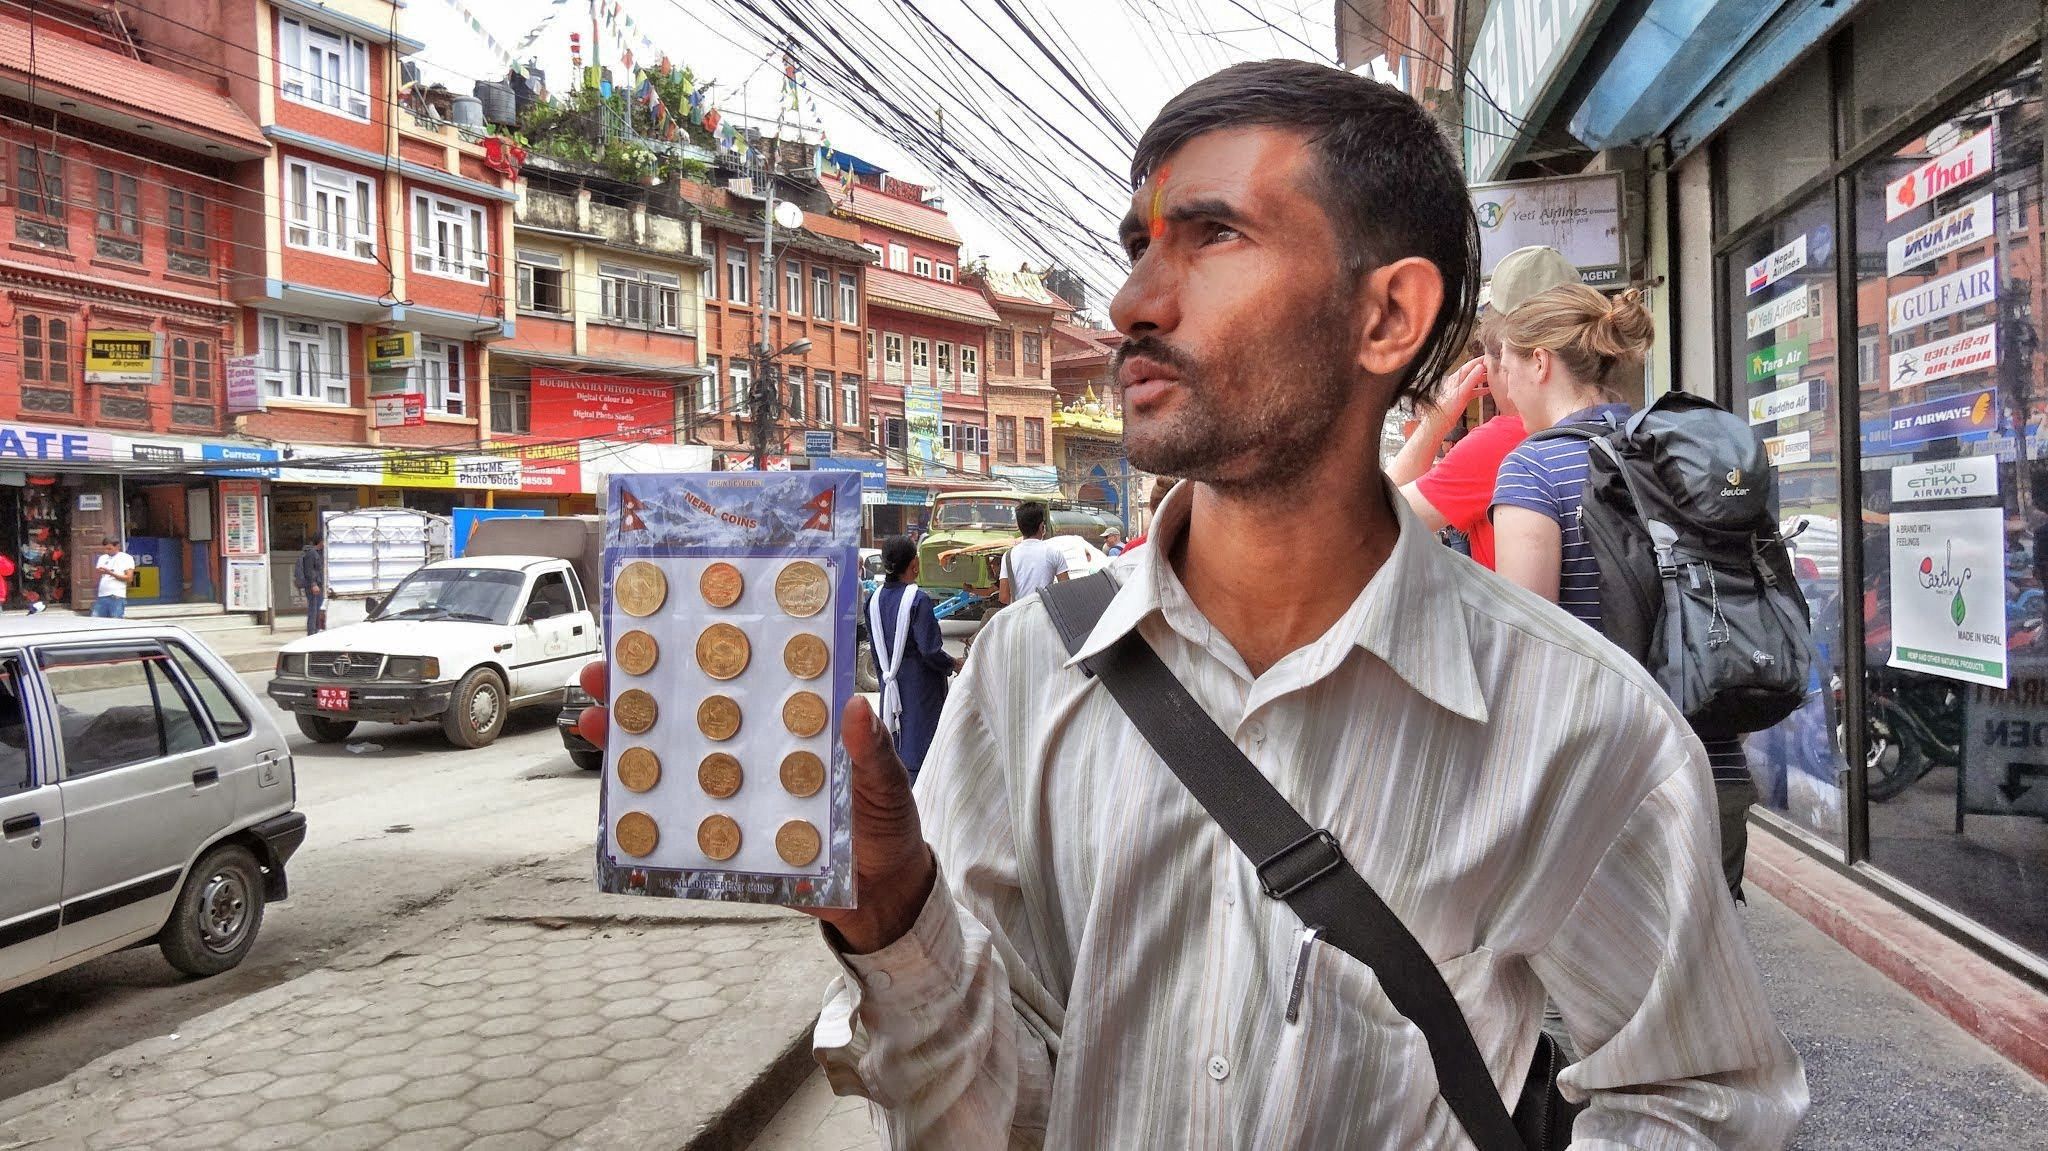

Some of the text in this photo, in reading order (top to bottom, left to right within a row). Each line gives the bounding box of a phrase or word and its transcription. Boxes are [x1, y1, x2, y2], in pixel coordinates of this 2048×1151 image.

[1924, 150, 1974, 199] Thai
[1513, 210, 1535, 222] Yeti
[1540, 207, 1588, 219] Airlines
[1774, 247, 1795, 266] Nepal
[1773, 257, 1800, 277] Airlines
[1581, 270, 1617, 282] AGENT
[1903, 270, 1991, 321] GULF AIR
[1759, 296, 1806, 327] Yeti Airlines
[95, 343, 139, 352] WESTERN
[1763, 351, 1801, 373] Tara Air
[577, 392, 634, 405] Digital Colour Lab
[637, 388, 667, 398] CENTER
[602, 403, 608, 411] &
[1768, 396, 1807, 416] Buddha Air
[573, 409, 635, 421] Digital Photo Studio
[1893, 406, 1971, 431] JET AIRWAYS
[0, 429, 89, 462] ATE
[222, 449, 261, 461] Currency
[525, 446, 579, 461] EXCHANGE
[476, 462, 503, 473] ACME
[460, 474, 518, 485] Photo Goods
[1907, 473, 1977, 489] ETIHAD
[1720, 487, 1750, 497] deuter
[1913, 487, 1968, 498] AIRWAYS
[684, 492, 757, 529] NEPAL COINS
[1901, 525, 1917, 533] BRAND
[1918, 524, 1931, 533] WITH
[1896, 538, 1920, 547] FEELINGS
[1957, 631, 2002, 646] MADE IN NEPAL
[673, 879, 691, 889] ALL
[694, 880, 744, 892] DIFFERENT
[747, 882, 774, 894] COINS
